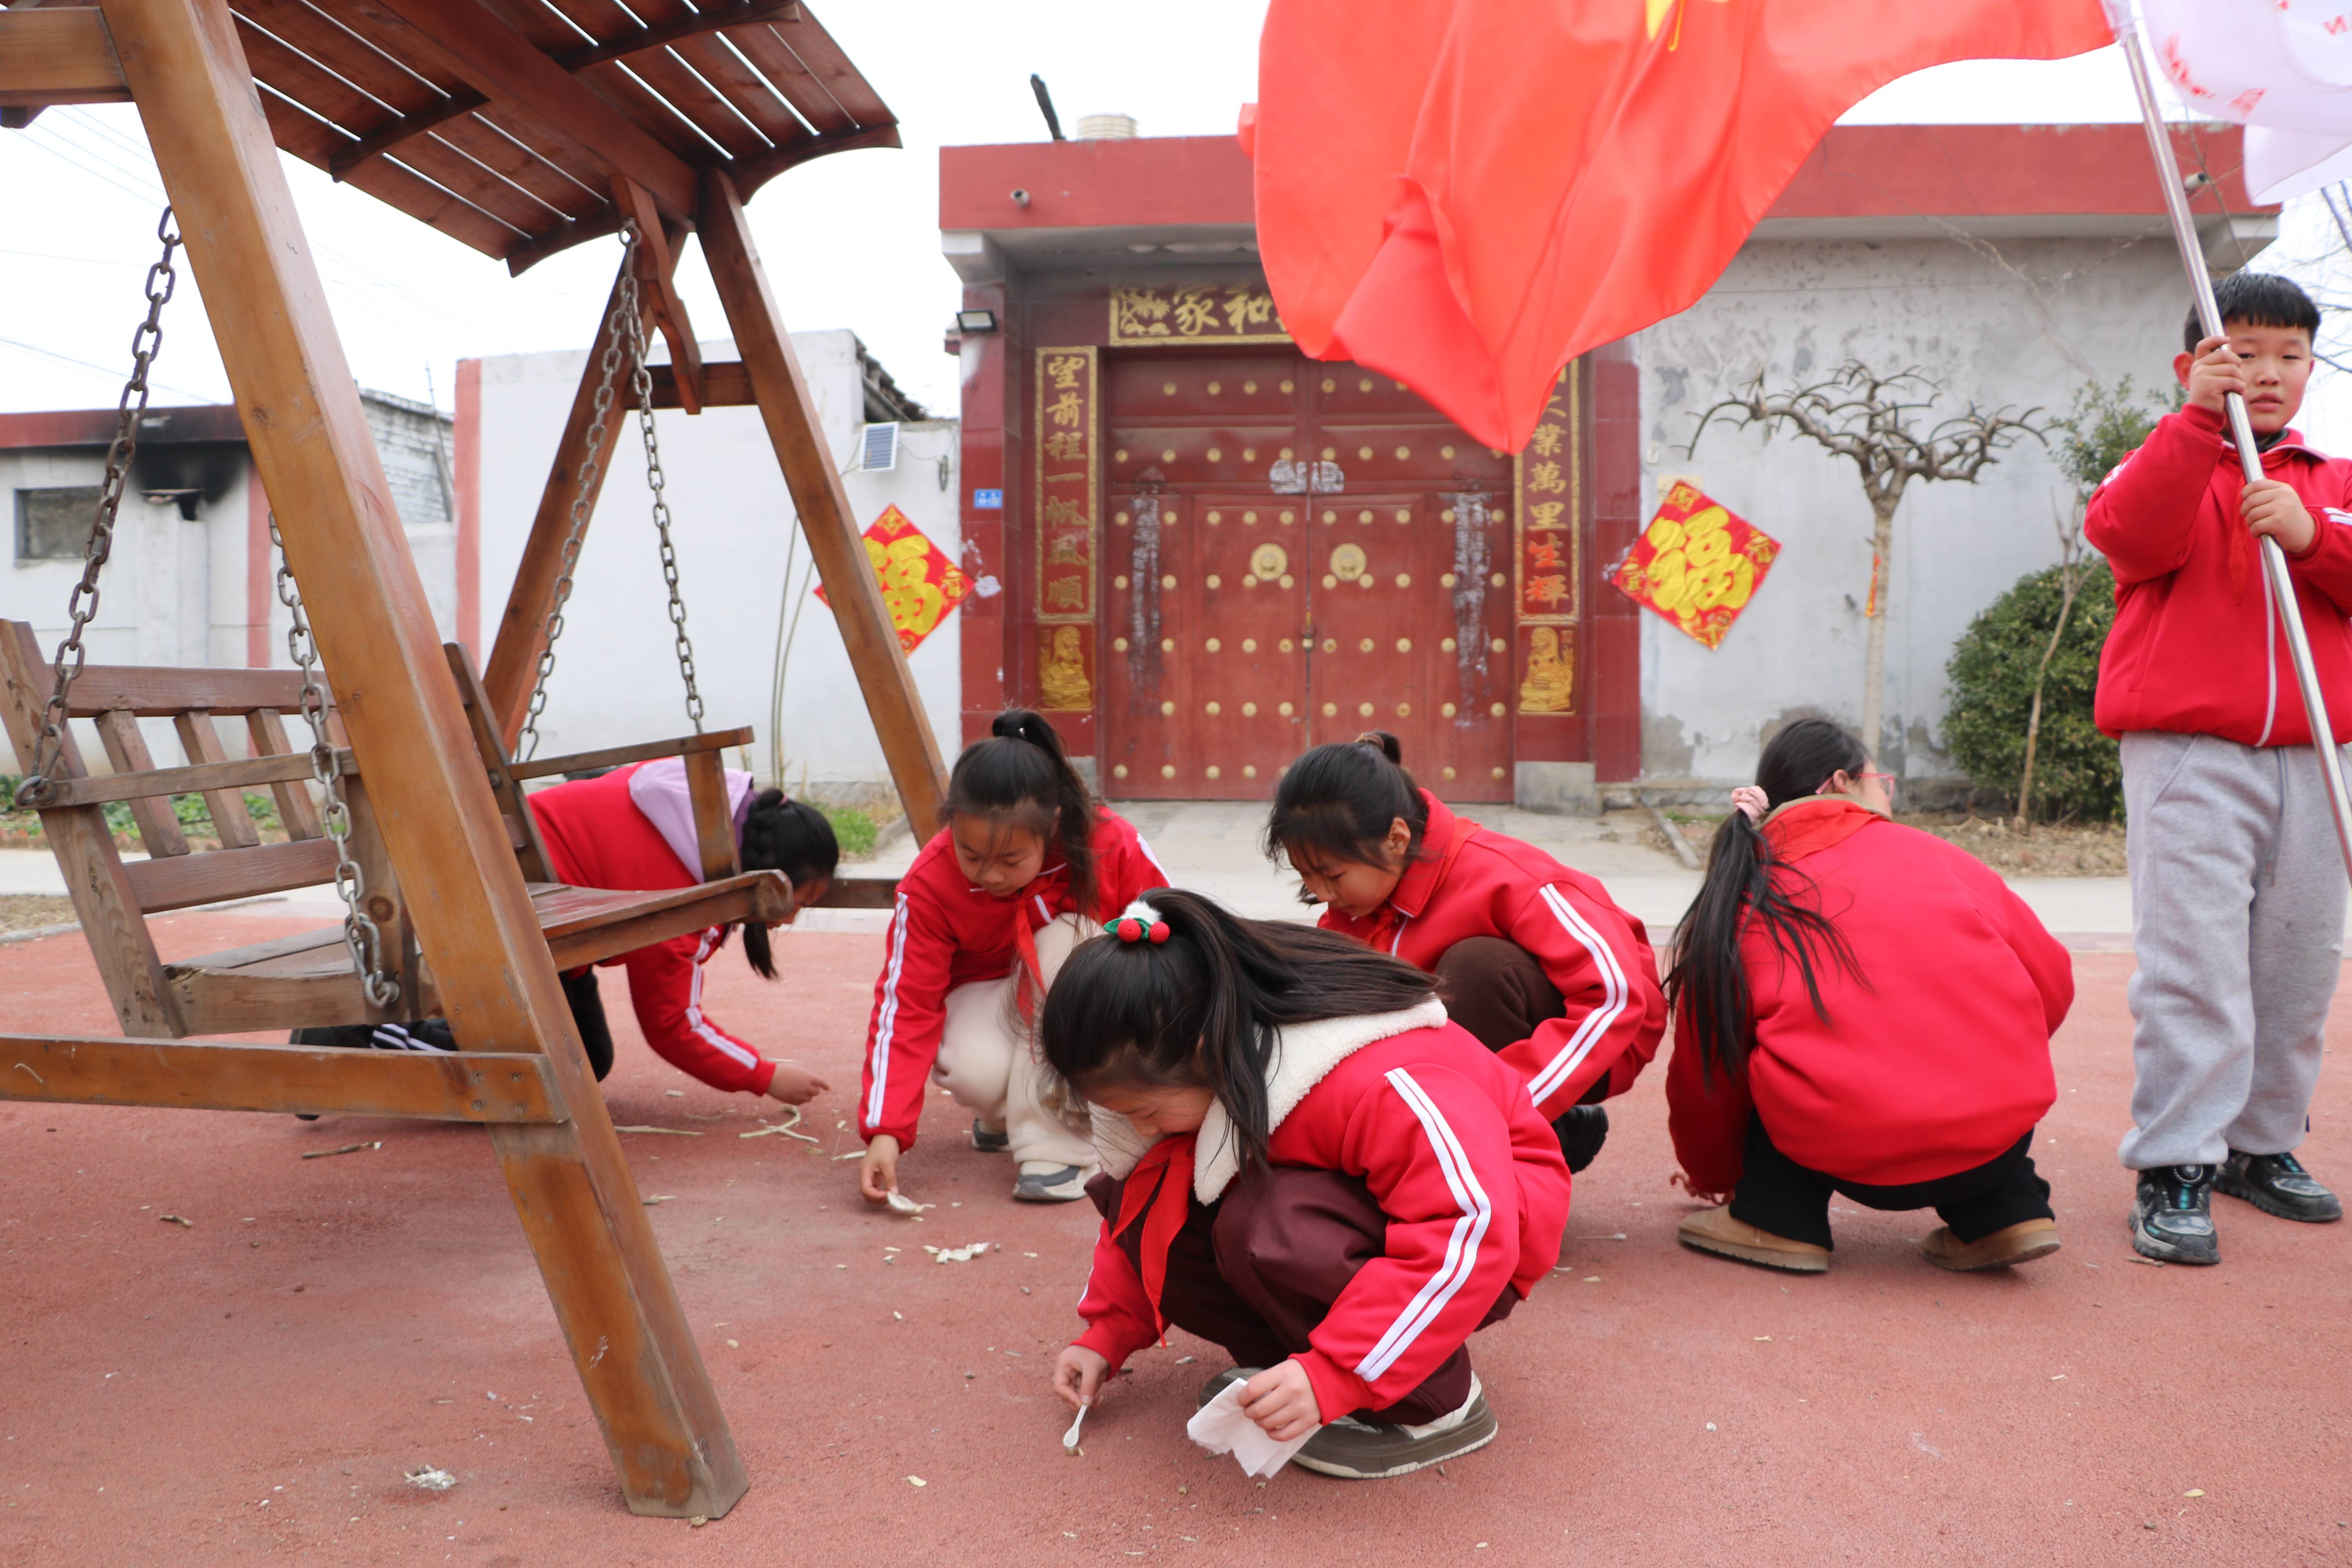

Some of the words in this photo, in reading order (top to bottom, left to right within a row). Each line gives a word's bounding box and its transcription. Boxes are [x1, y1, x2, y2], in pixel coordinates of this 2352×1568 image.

[1173, 286, 1287, 335] 家和
[1045, 355, 1087, 609] 望前程一帆風順
[1524, 365, 1570, 610] 業萬里生輝
[1647, 505, 1754, 620] 福
